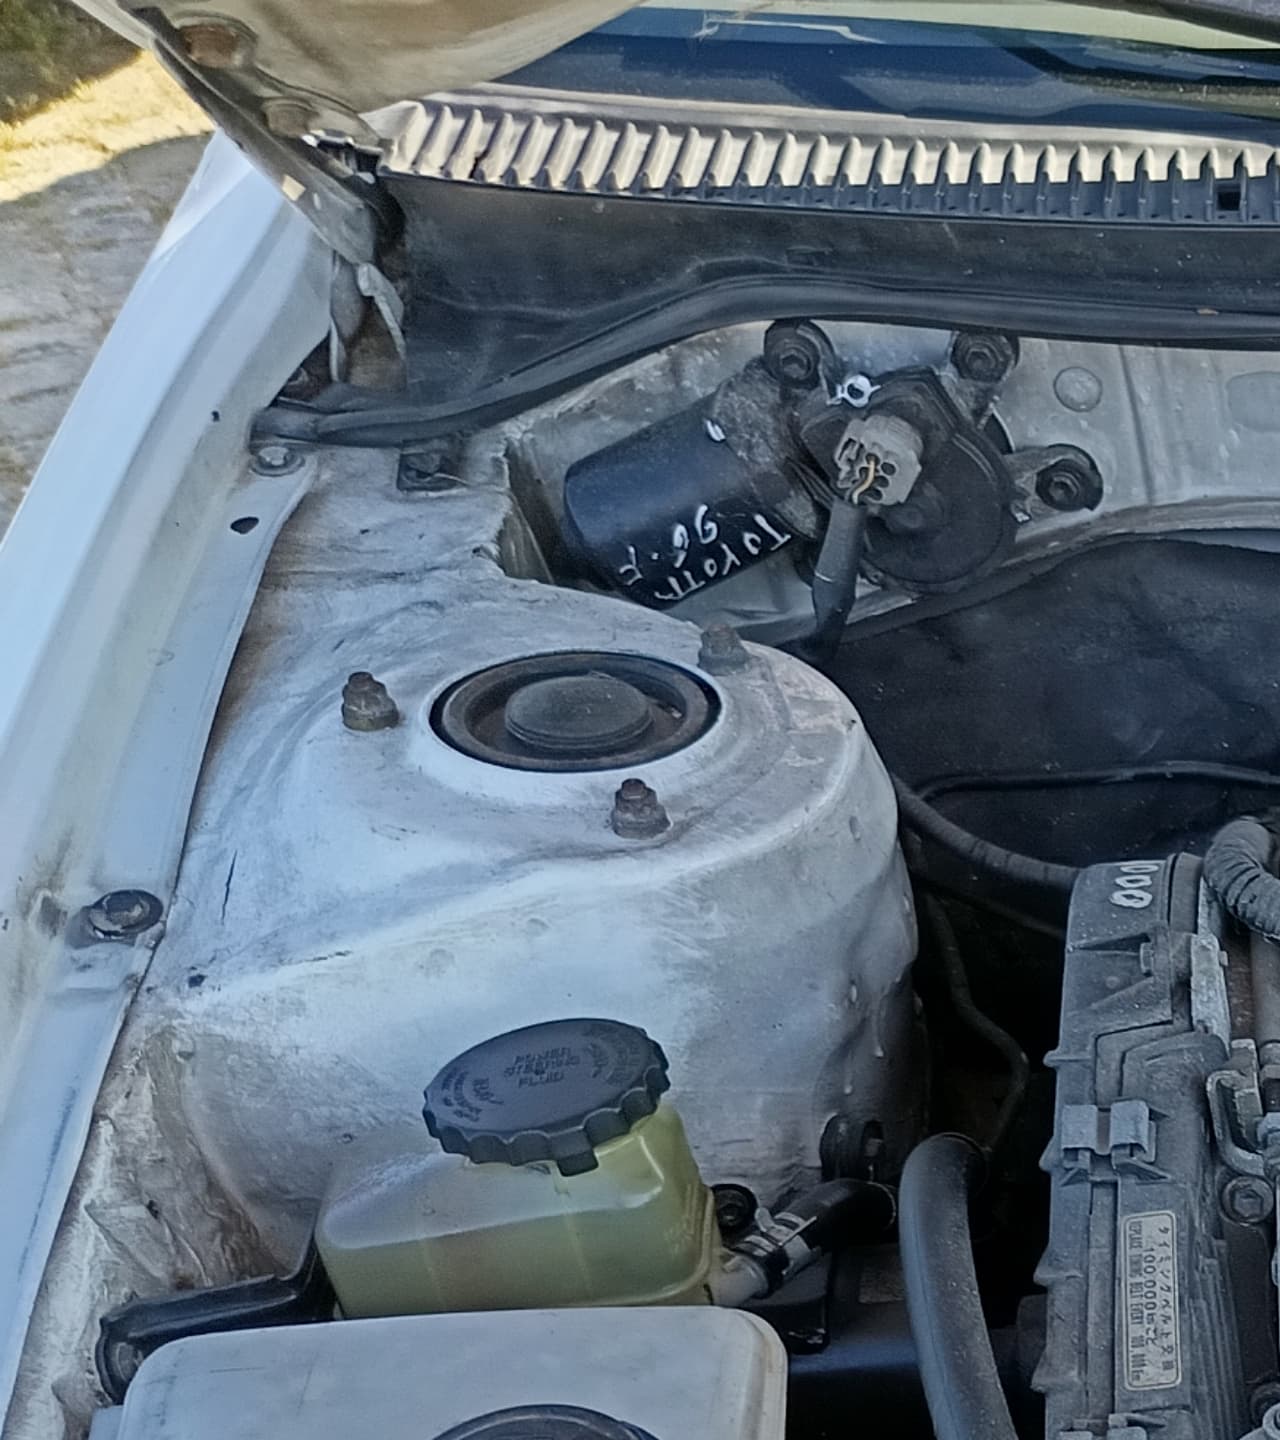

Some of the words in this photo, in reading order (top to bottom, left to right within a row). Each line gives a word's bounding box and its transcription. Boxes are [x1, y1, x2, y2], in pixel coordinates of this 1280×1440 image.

[513, 1046, 572, 1064] POWER
[503, 1055, 580, 1077] STEERING
[518, 1070, 565, 1088] FLUID
